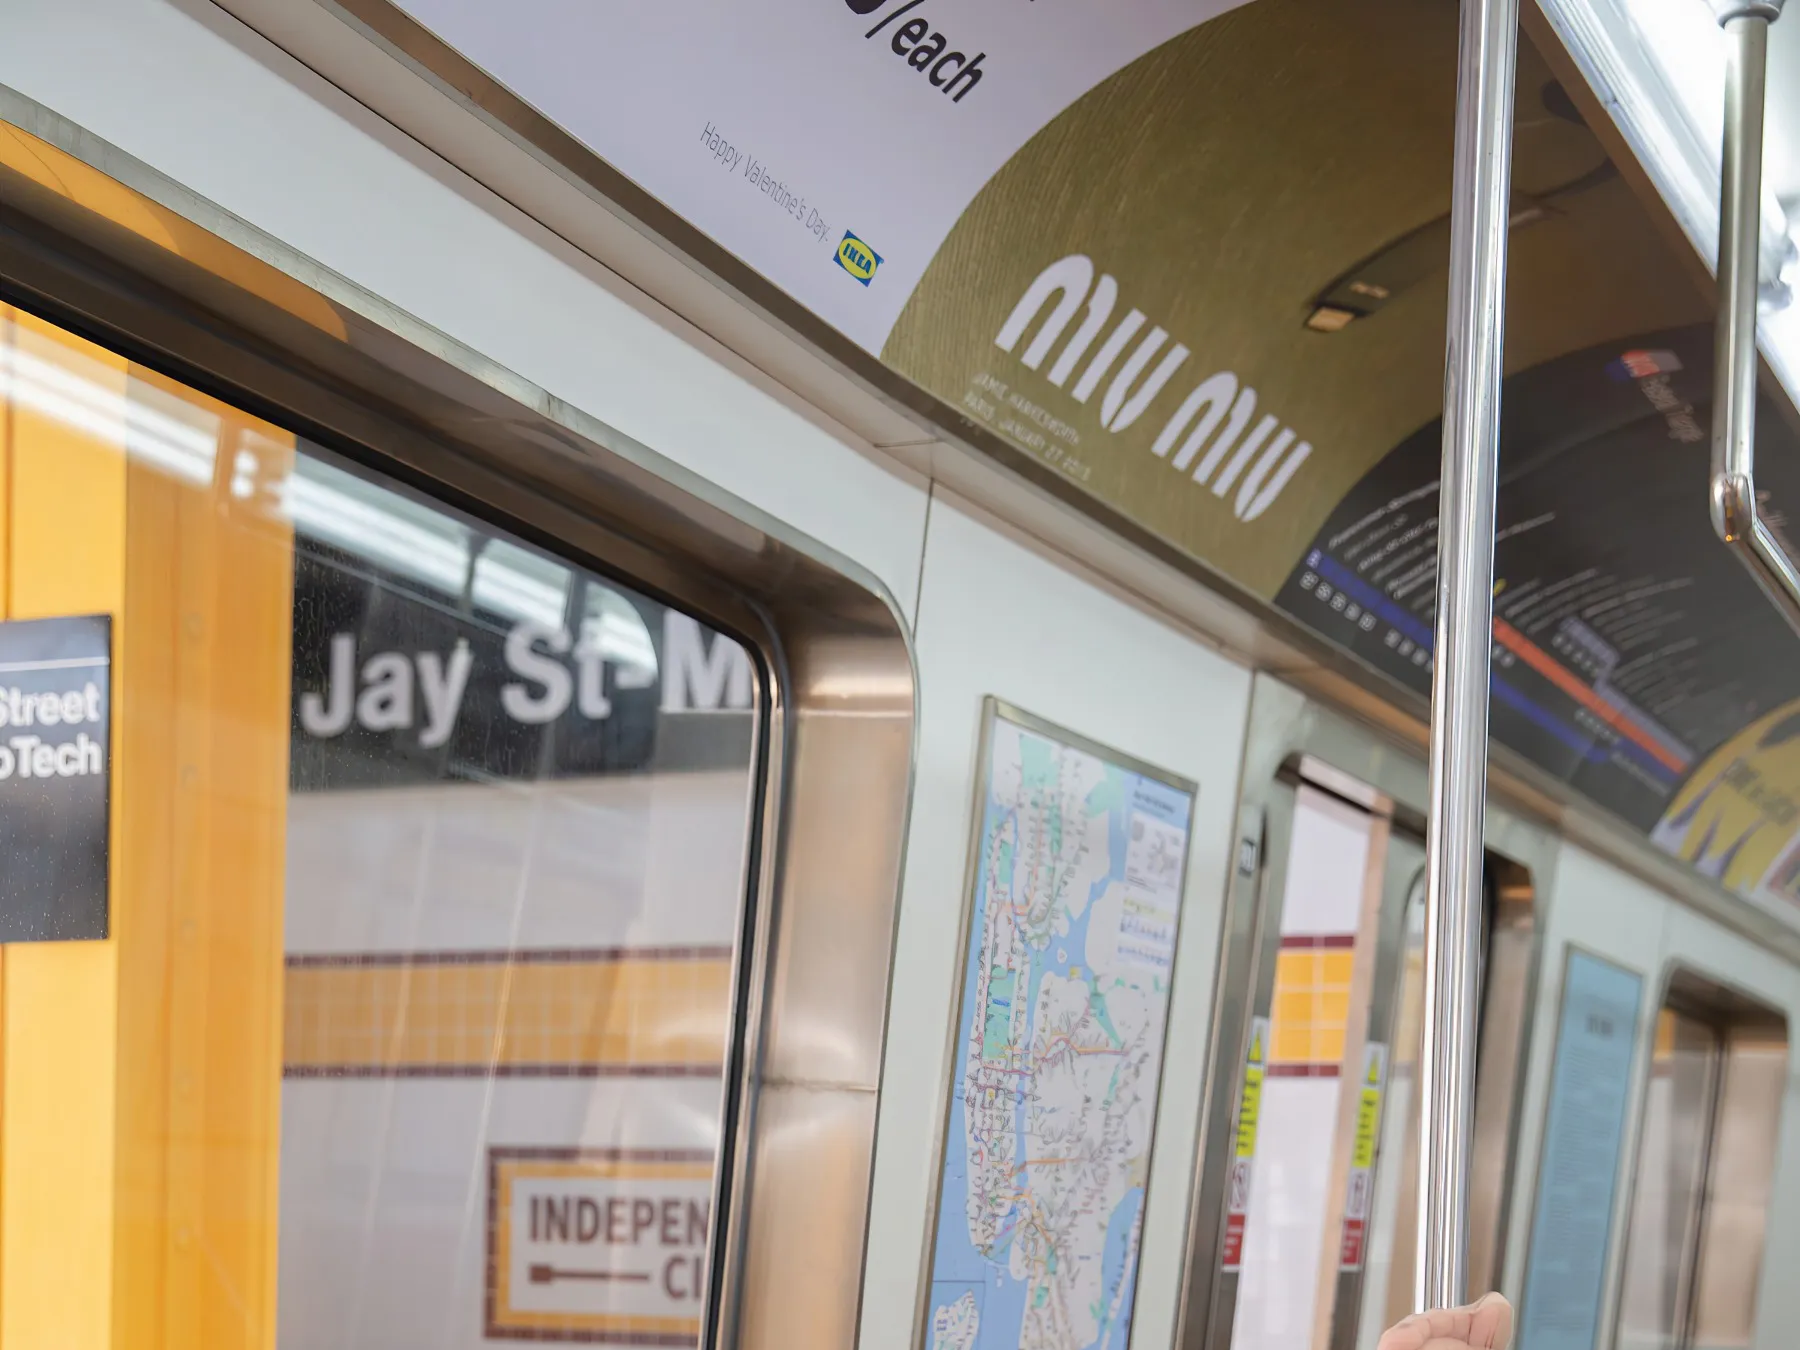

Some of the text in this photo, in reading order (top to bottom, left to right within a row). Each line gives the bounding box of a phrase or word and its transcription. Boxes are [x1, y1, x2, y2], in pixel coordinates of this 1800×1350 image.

[845, 0, 986, 103] /each
[700, 121, 831, 243] Happy Valentine's Day.
[301, 633, 474, 749] Jay
[529, 1194, 711, 1246] INDEPEN
